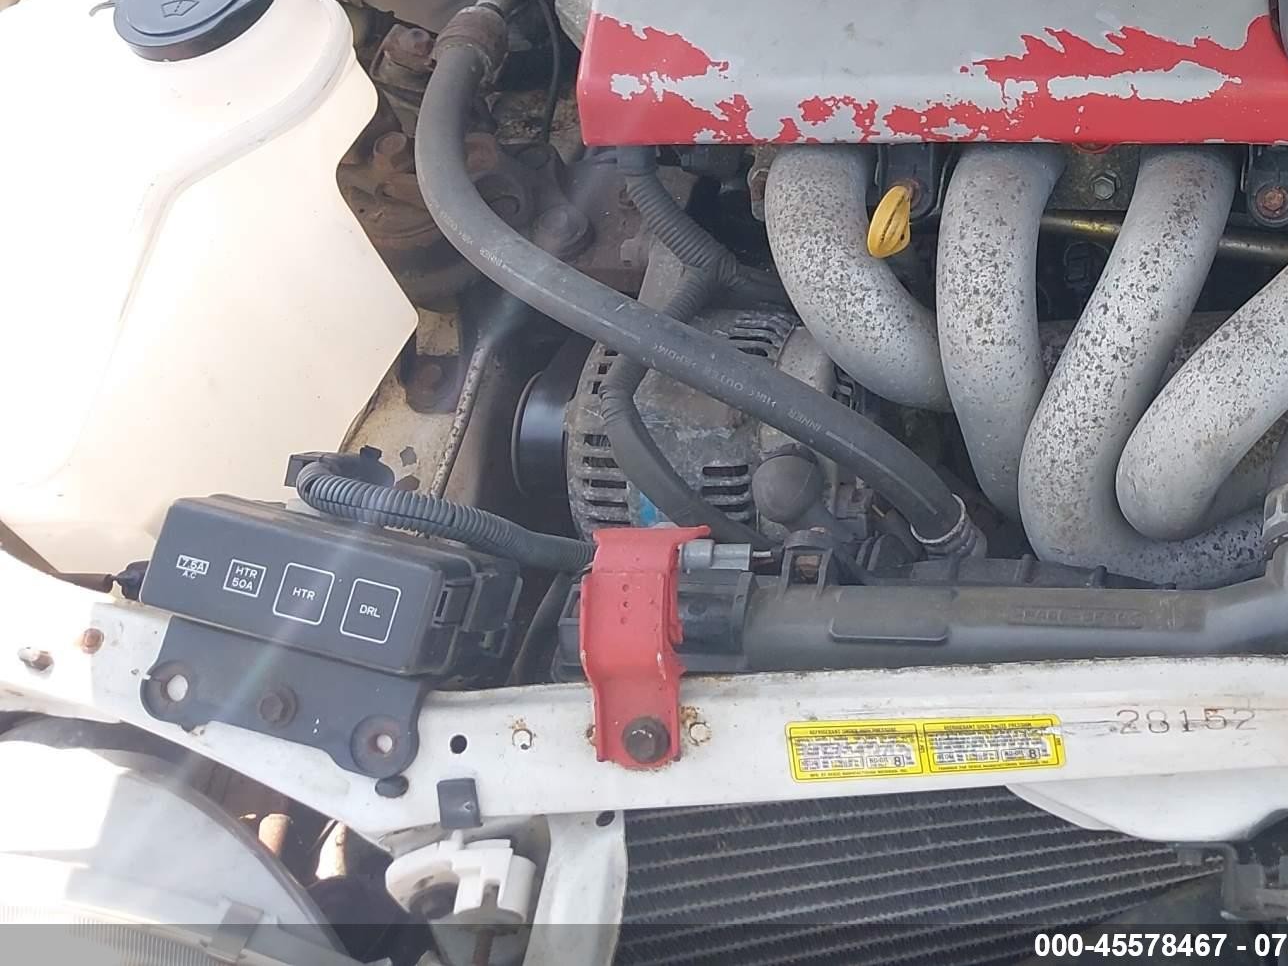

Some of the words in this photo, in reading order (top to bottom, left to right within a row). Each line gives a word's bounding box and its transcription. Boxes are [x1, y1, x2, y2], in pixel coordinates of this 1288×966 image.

[235, 565, 258, 579] HTR
[232, 577, 253, 591] 50A
[292, 586, 316, 601] HTR
[359, 604, 381, 618] DRL
[1116, 707, 1257, 734] 28152
[1029, 748, 1036, 759] 8
[894, 756, 901, 767] 8
